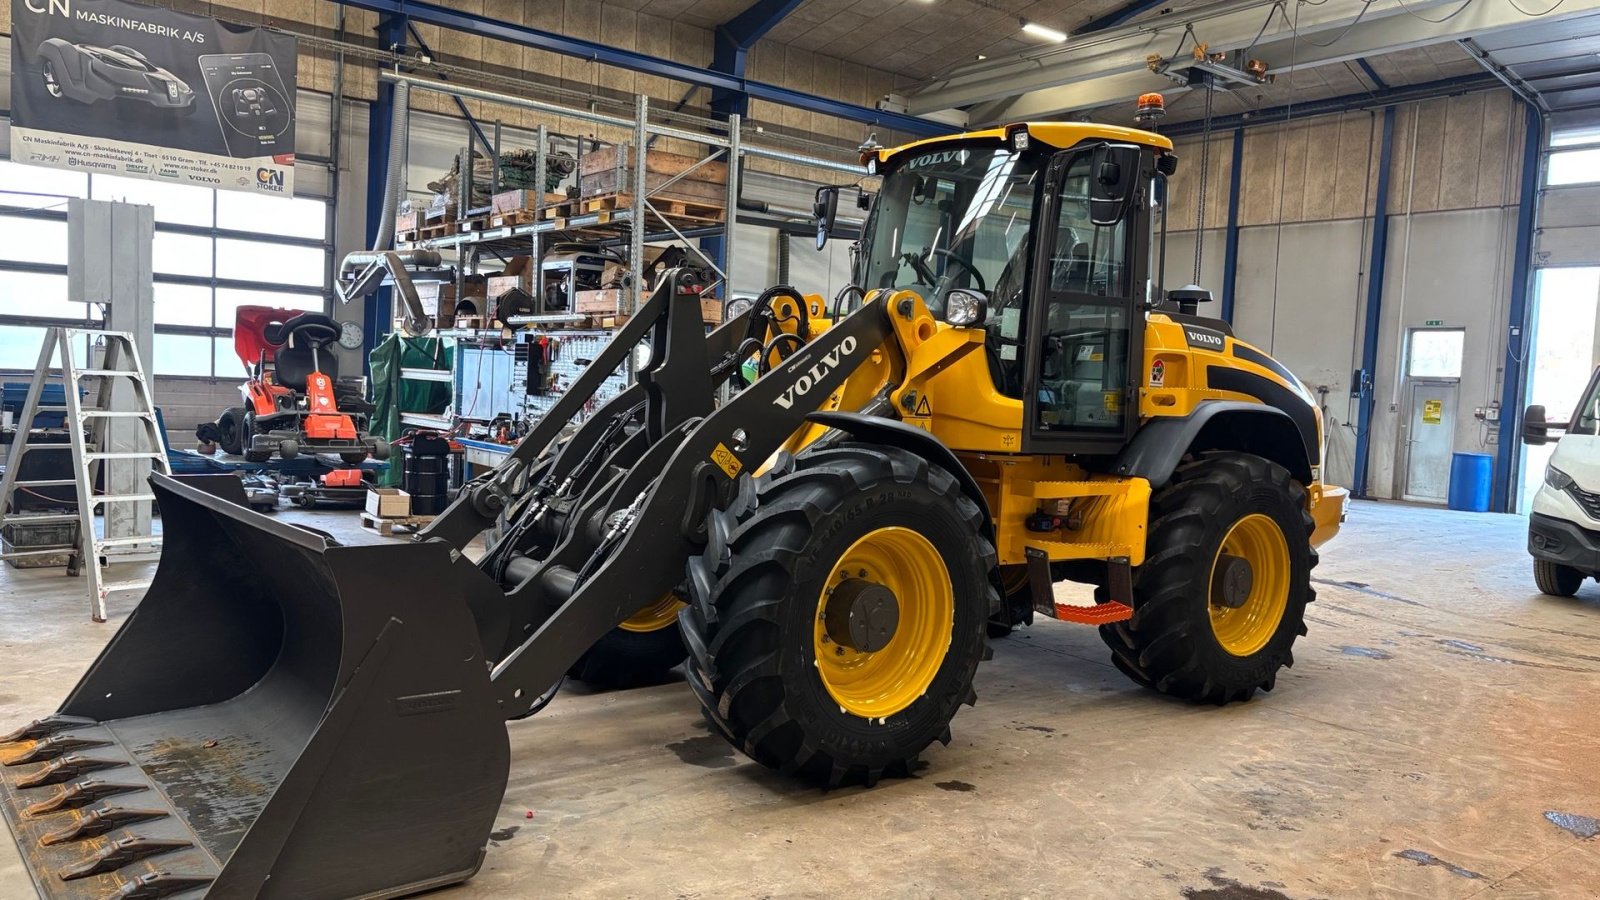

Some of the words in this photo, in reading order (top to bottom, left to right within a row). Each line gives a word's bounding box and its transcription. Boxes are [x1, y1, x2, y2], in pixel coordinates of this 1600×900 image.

[24, 0, 70, 18] CN
[76, 10, 180, 39] MASKINFABRIK
[182, 31, 205, 43] A/S
[34, 137, 76, 148] Maskinfabrik
[65, 149, 144, 164] www.cn-maskinfabrik.dk
[909, 150, 971, 169] VOLVO
[77, 160, 117, 170] Husqvarna
[164, 163, 218, 174] www.cn-stoker.dk
[188, 174, 221, 184] VOLVO
[256, 167, 284, 186] CN
[257, 183, 284, 192] STOKER
[1188, 331, 1222, 345] VOLVO
[772, 336, 857, 410] VOLVO
